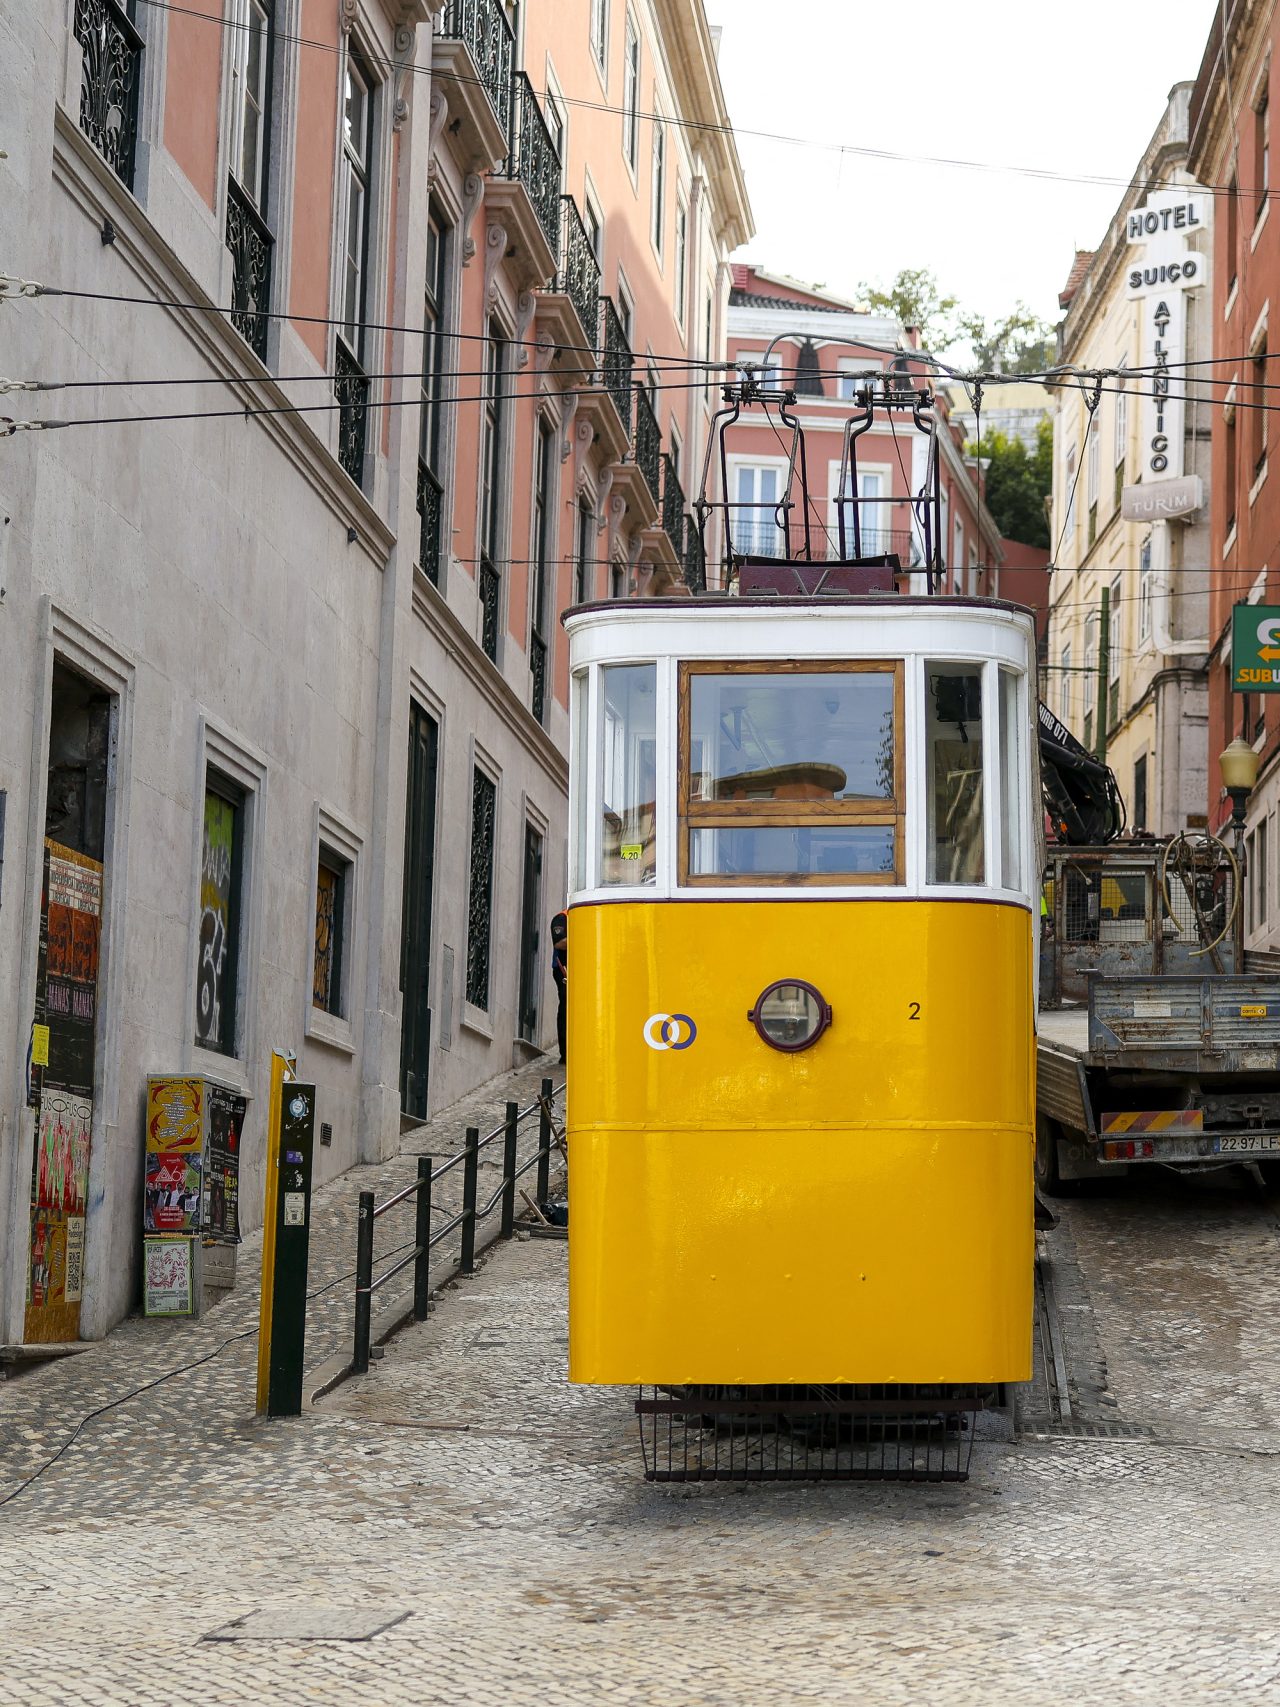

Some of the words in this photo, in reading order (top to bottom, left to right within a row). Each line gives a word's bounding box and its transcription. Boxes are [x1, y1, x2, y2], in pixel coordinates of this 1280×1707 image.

[1129, 203, 1200, 238] HOTEL
[1129, 260, 1197, 289] SUIÇO
[1132, 494, 1188, 514] TURIM
[908, 1001, 921, 1020] 2
